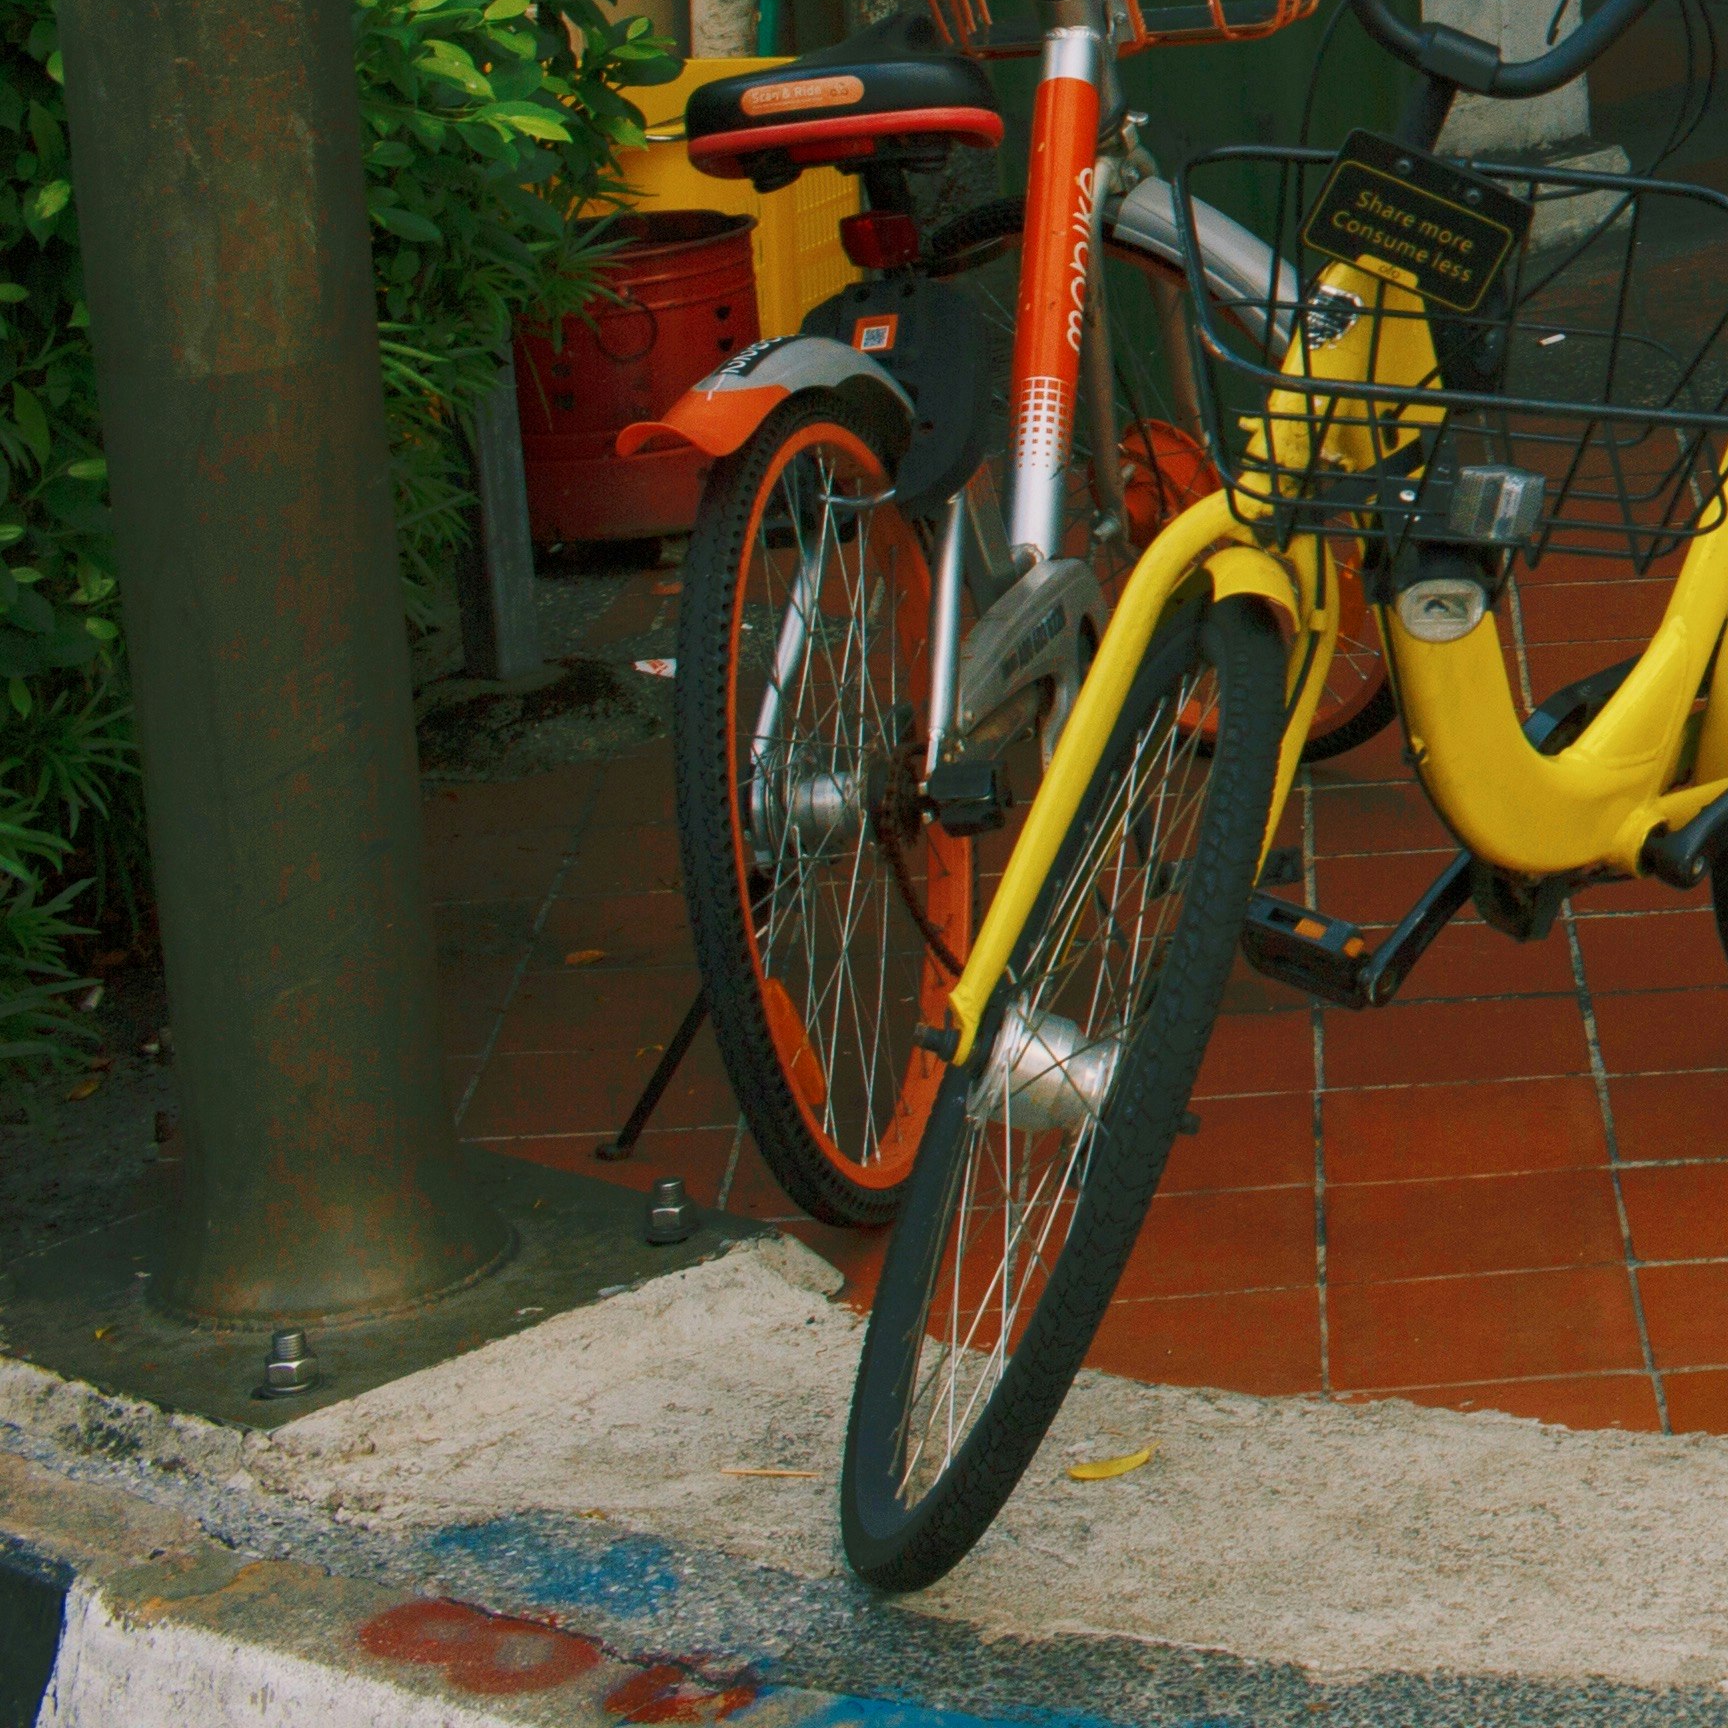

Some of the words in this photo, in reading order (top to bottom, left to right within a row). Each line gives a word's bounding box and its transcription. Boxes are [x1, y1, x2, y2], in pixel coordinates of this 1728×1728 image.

[1331, 210, 1429, 263] Consume
[1432, 251, 1473, 283] less
[1355, 190, 1415, 227] Share
[1419, 220, 1474, 253] more
